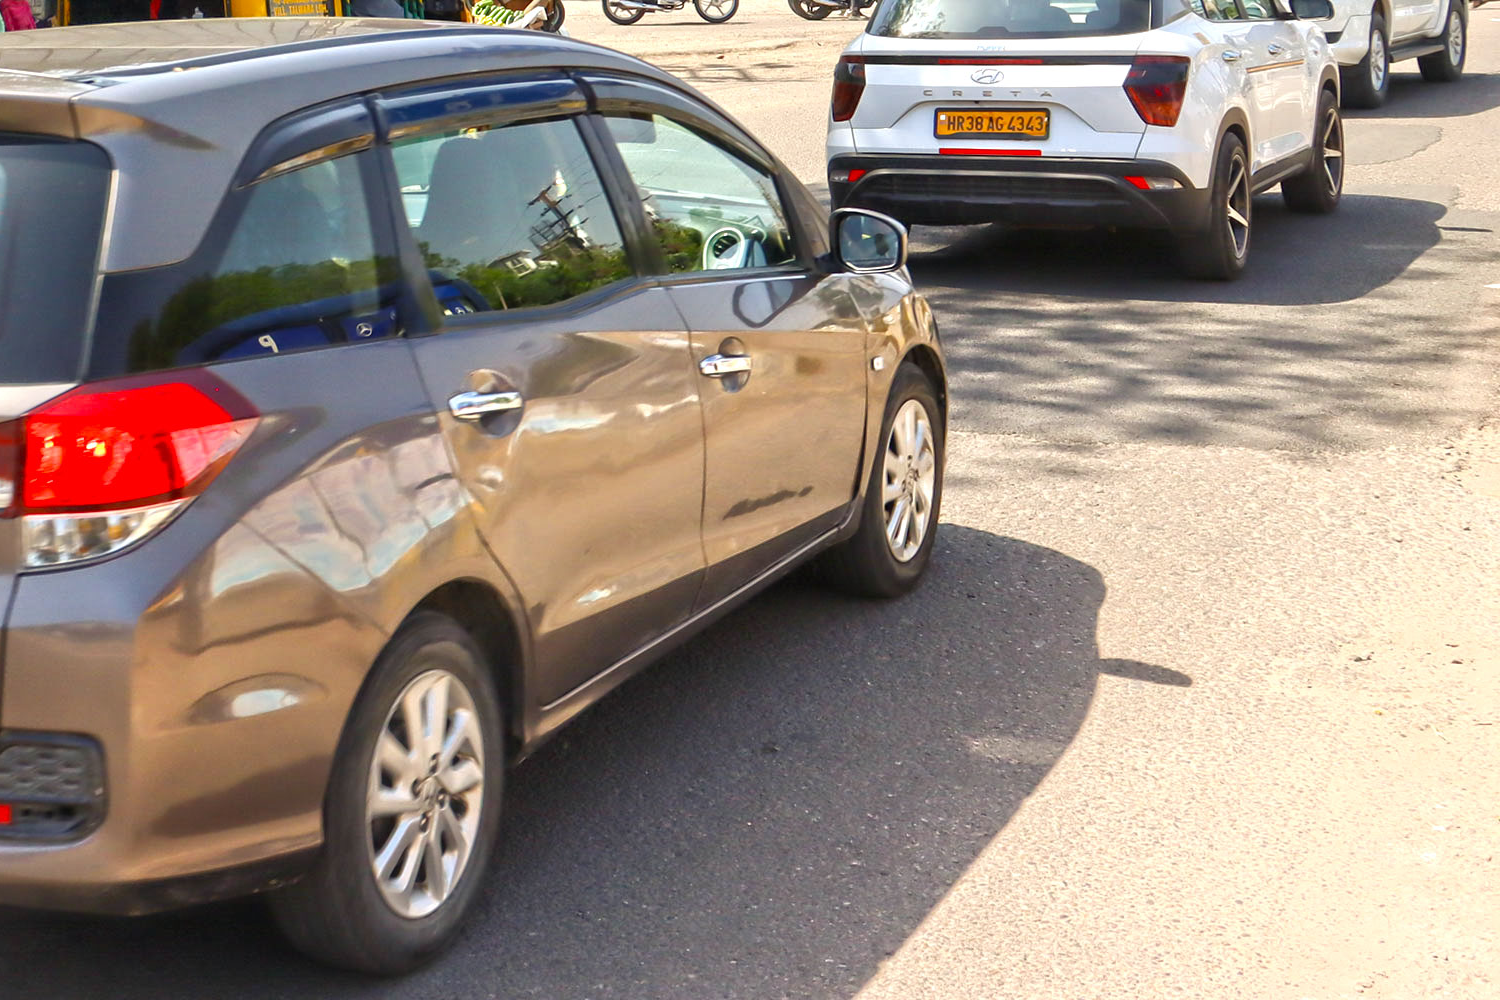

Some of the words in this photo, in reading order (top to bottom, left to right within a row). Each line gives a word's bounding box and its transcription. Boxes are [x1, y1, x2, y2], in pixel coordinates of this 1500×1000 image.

[923, 89, 1053, 98] CRETA
[947, 116, 984, 132] HR38
[987, 116, 1004, 132] AG
[1007, 115, 1044, 132] 4343
